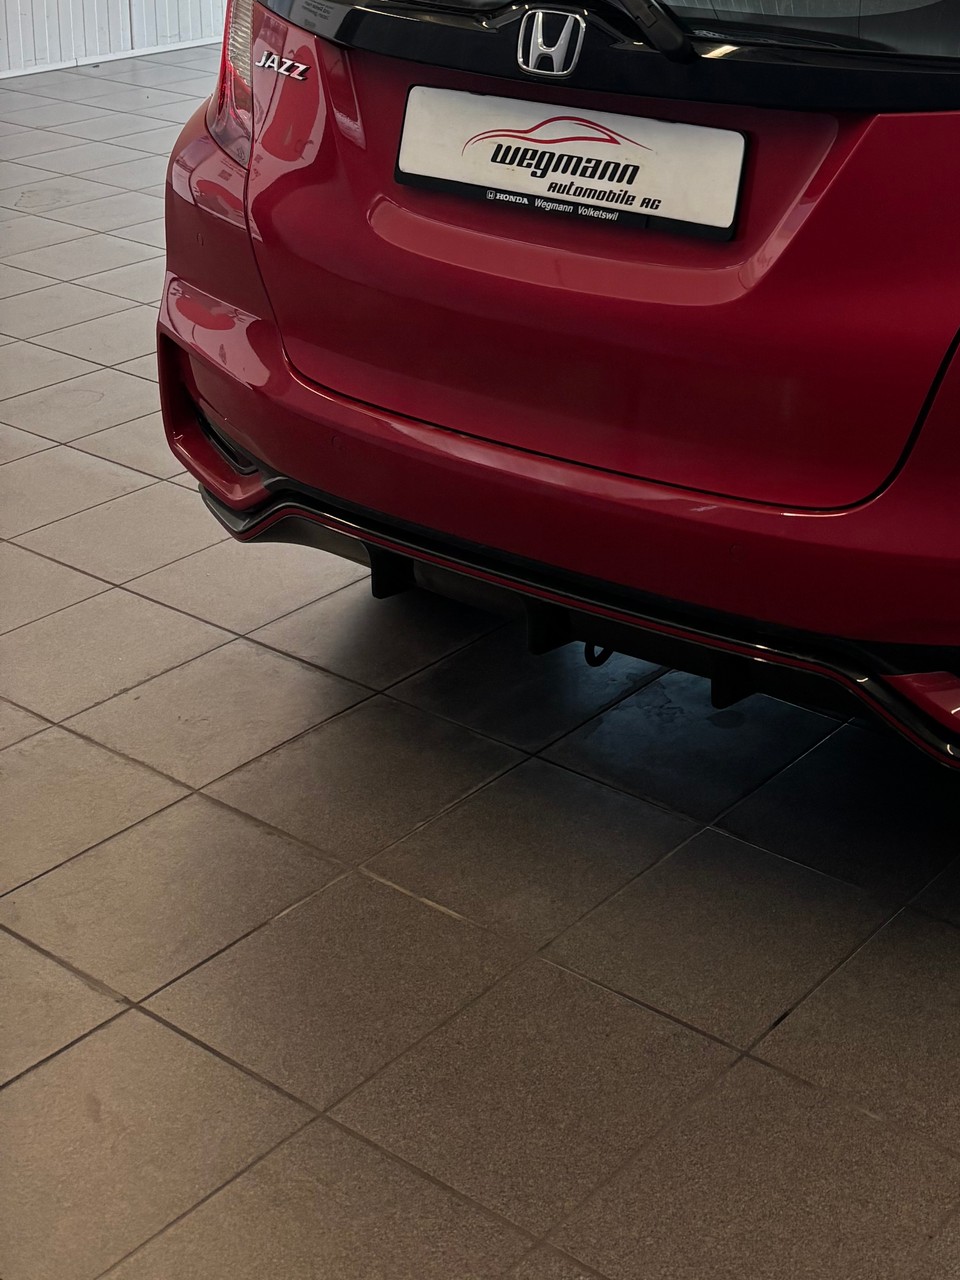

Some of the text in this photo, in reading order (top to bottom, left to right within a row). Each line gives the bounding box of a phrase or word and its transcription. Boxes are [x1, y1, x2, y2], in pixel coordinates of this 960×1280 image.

[255, 51, 311, 81] JAZZ
[491, 144, 640, 185] wegmann
[496, 192, 529, 205] HONDA
[534, 198, 574, 213] Wegmann
[577, 205, 619, 221] Volketswil
[639, 197, 662, 210] AG
